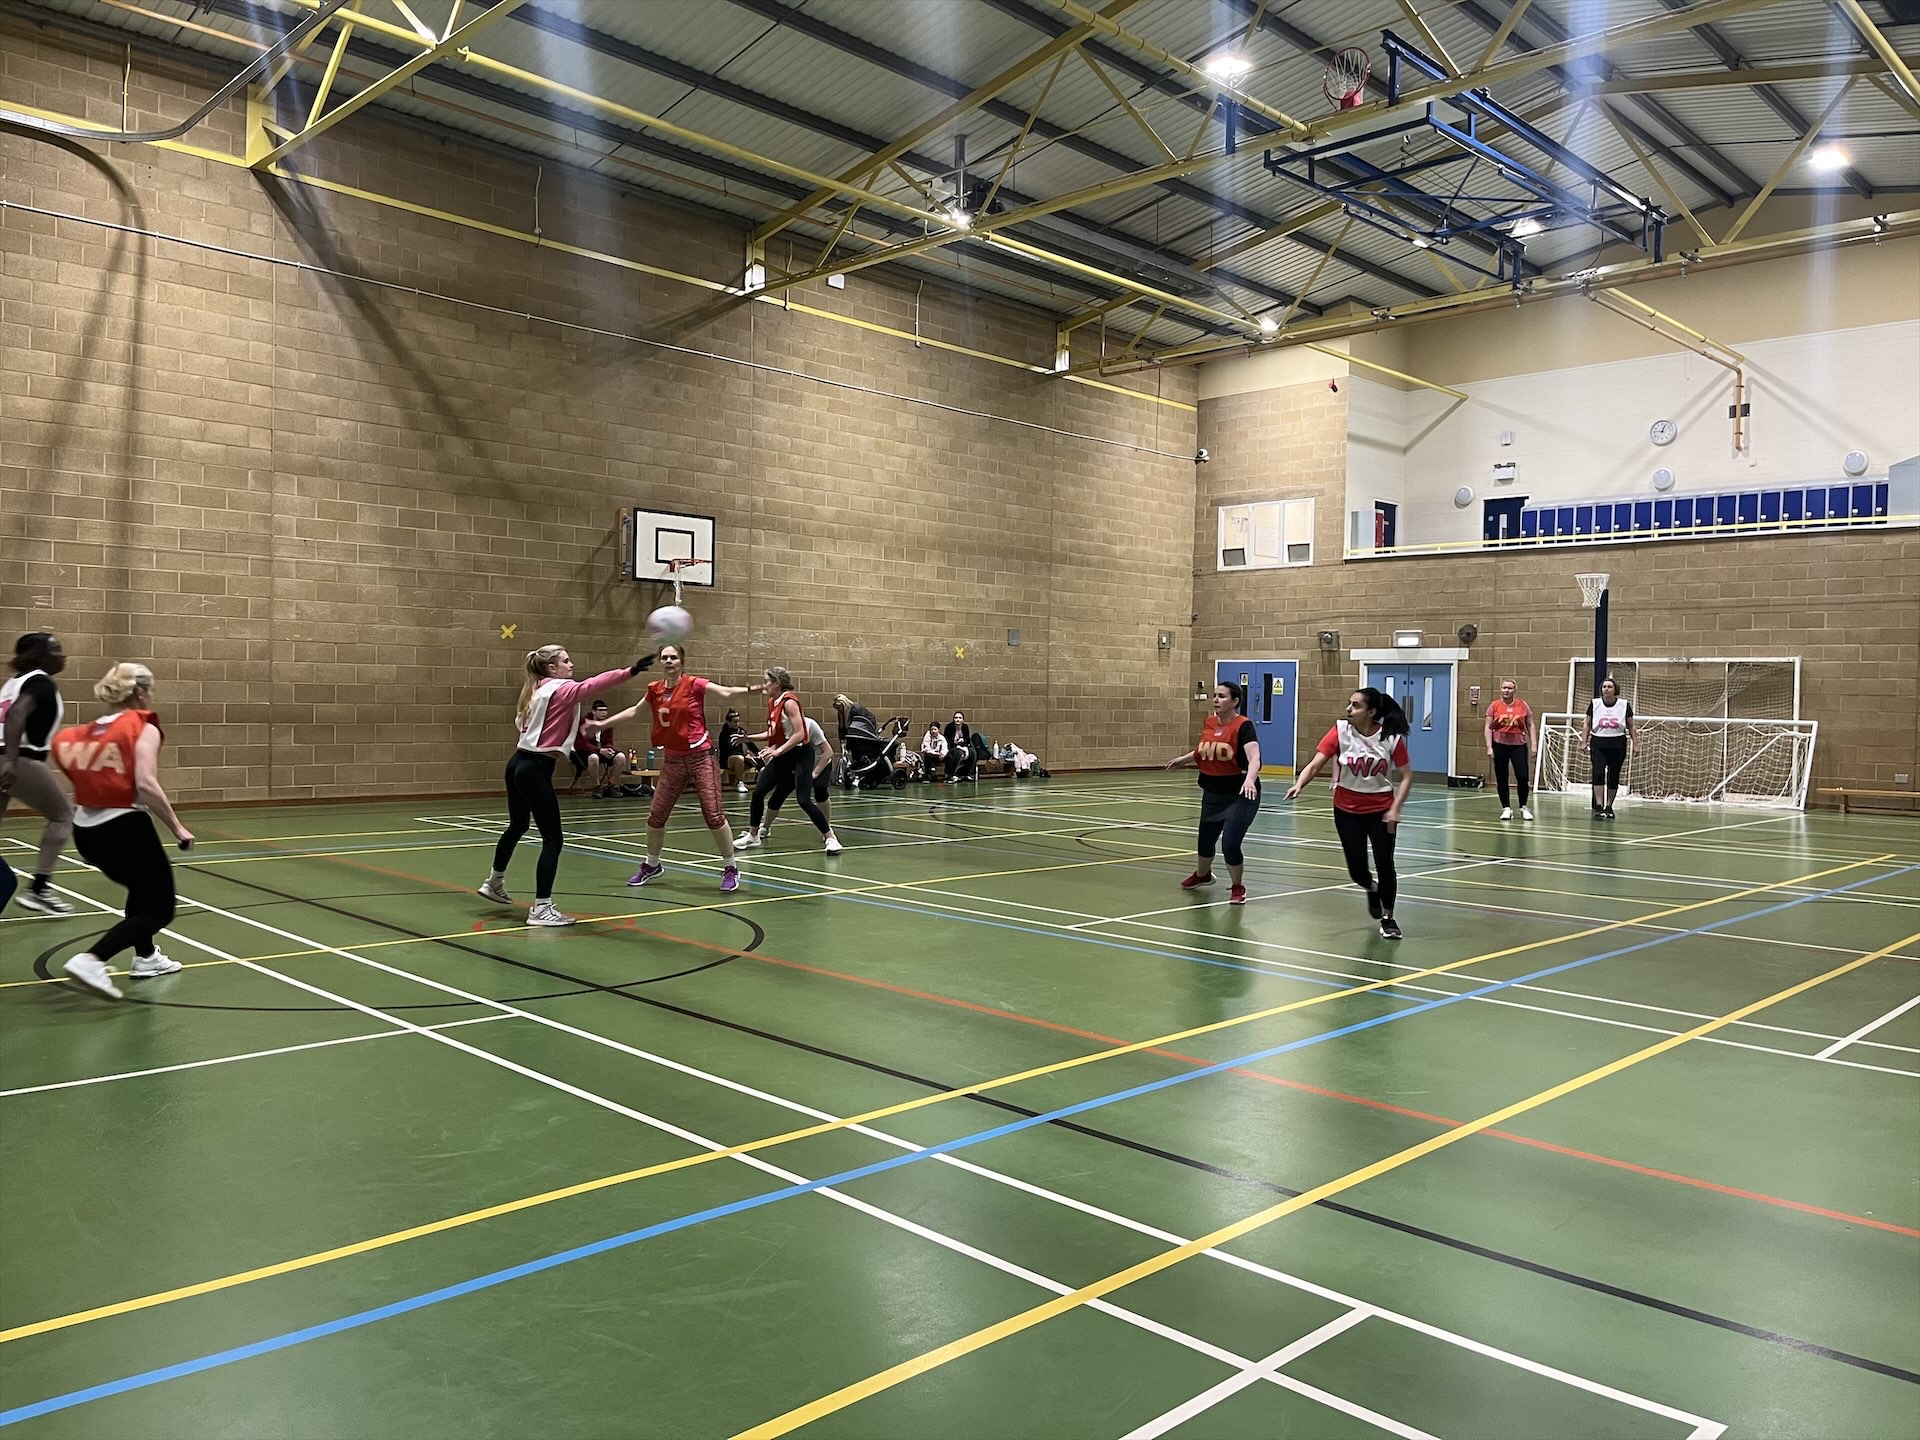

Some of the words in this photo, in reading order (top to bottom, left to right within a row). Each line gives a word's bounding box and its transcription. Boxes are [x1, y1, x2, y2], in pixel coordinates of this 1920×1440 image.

[658, 707, 670, 727] C
[1599, 718, 1619, 729] GS
[58, 741, 125, 774] WA
[1198, 741, 1233, 761] WD
[1347, 757, 1388, 777] WA
